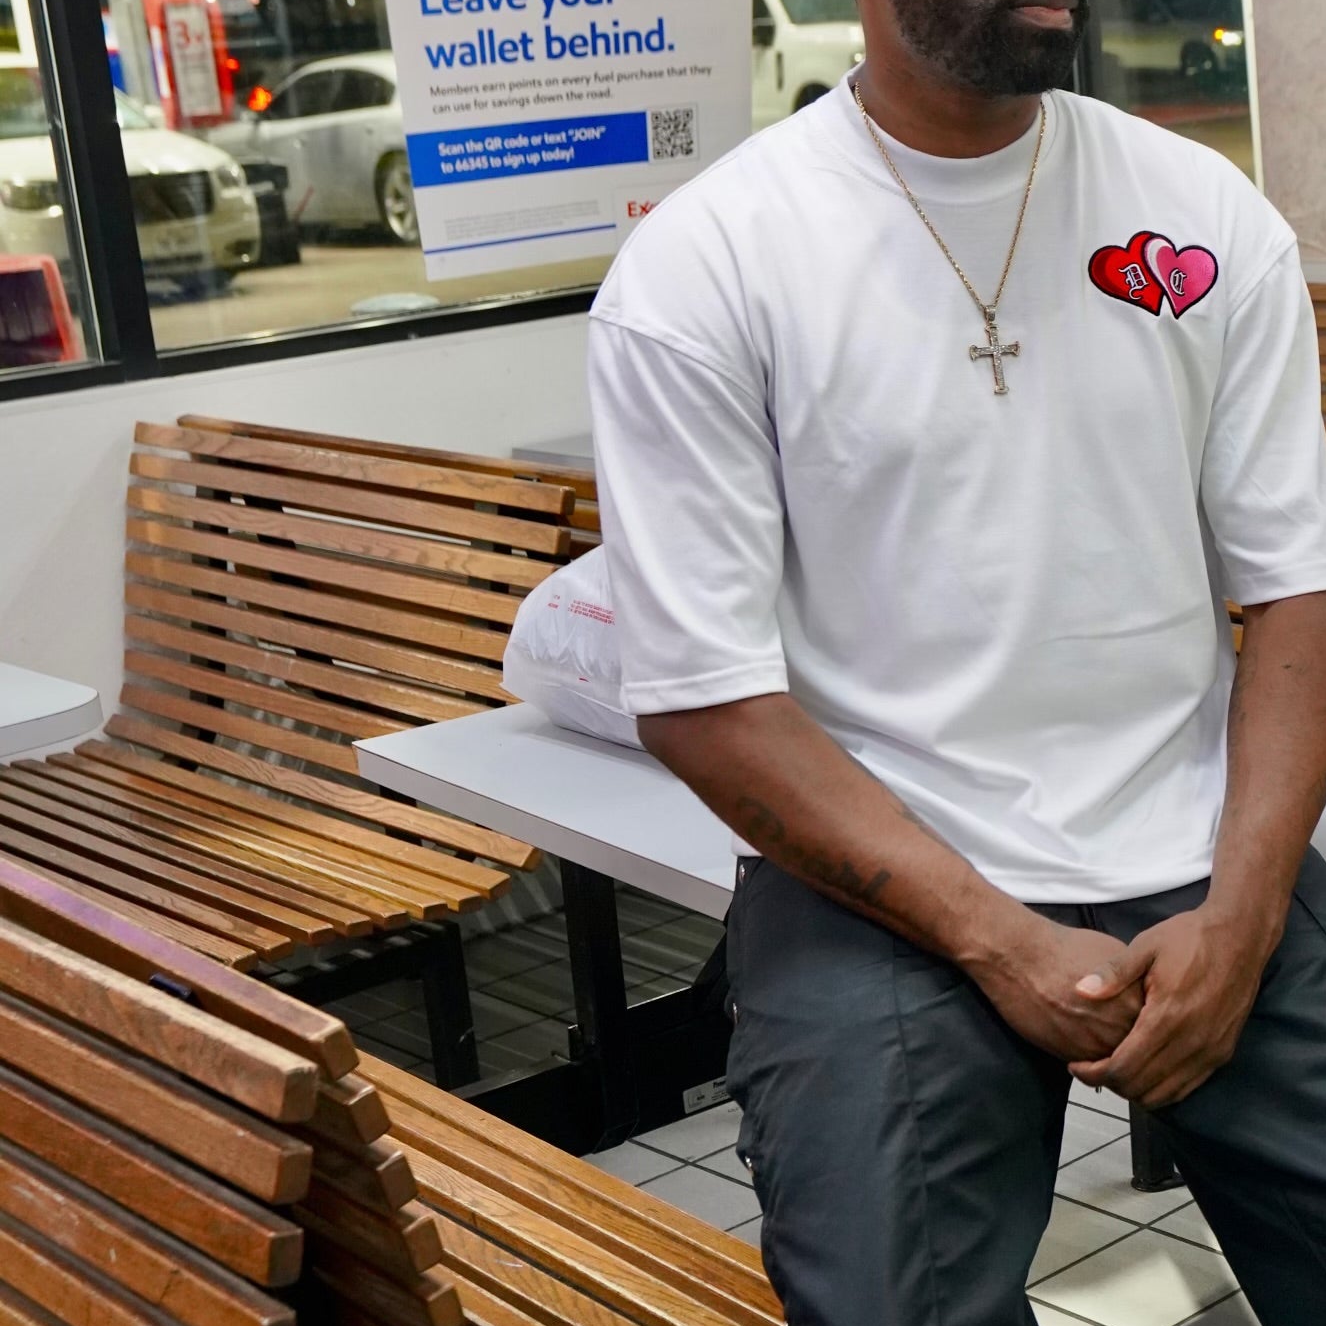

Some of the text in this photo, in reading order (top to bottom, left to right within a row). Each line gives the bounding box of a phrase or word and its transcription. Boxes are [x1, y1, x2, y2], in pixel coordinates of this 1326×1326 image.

[425, 17, 675, 70] wallet behind.
[430, 65, 712, 96] Members earn points on every fuel purchase that they
[432, 104, 451, 114] can
[453, 102, 471, 112] use
[474, 99, 488, 110] for
[491, 95, 531, 110] savings
[533, 93, 563, 105] down
[566, 90, 584, 101] the
[438, 142, 465, 157] Scan
[465, 139, 484, 154] the
[484, 136, 503, 152] QR
[503, 133, 530, 149] code
[530, 135, 542, 147] or
[543, 131, 567, 145] text
[440, 146, 575, 174] to 66345 to sign up today!
